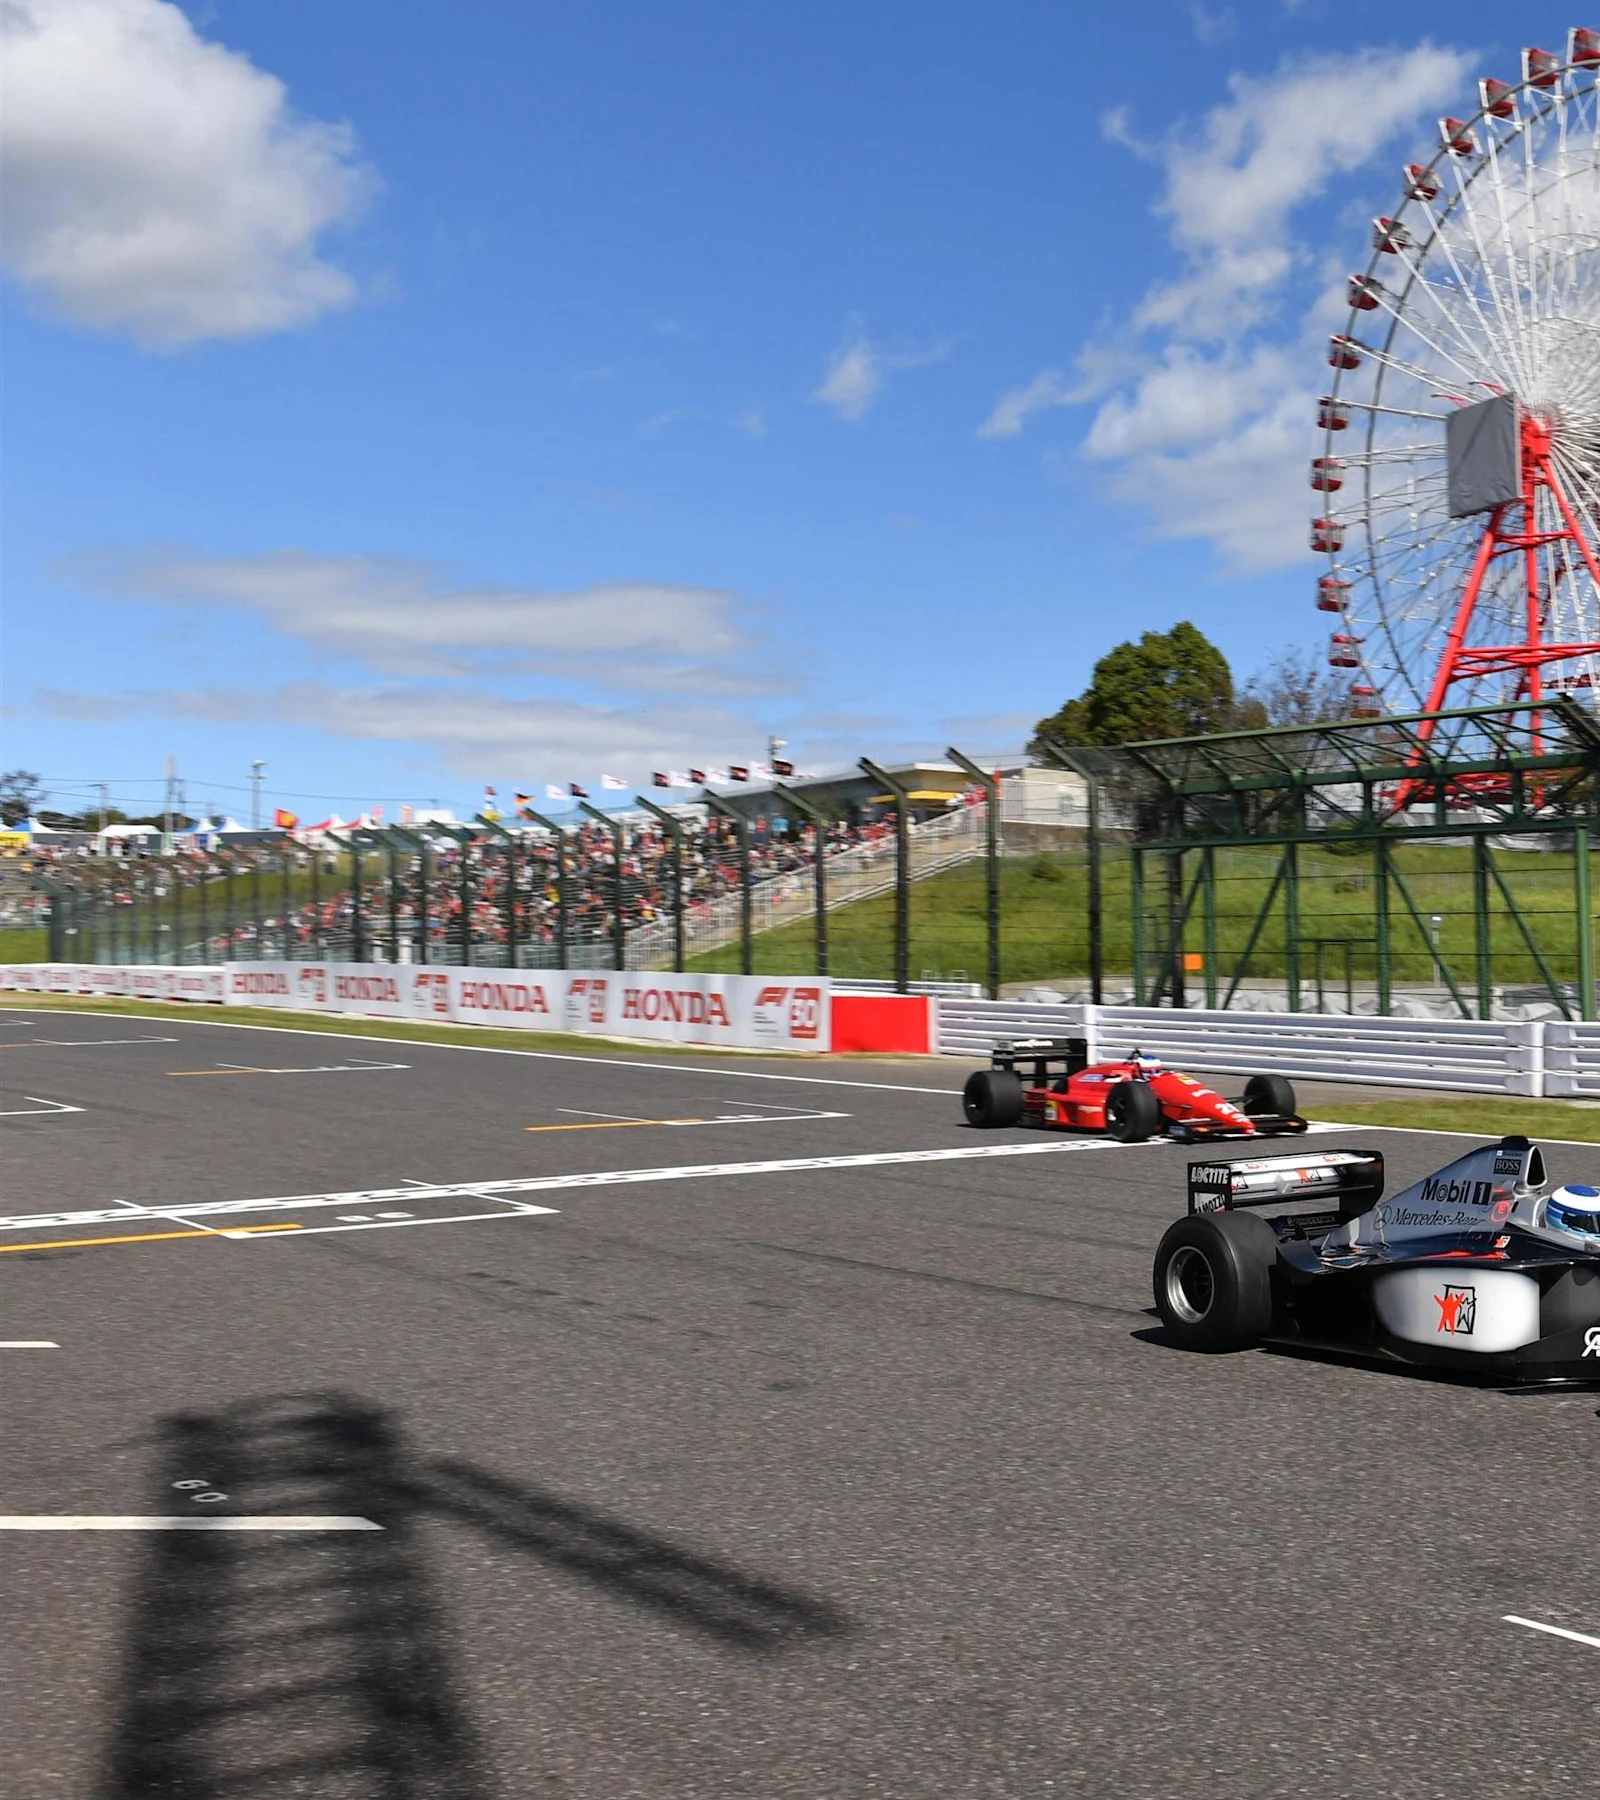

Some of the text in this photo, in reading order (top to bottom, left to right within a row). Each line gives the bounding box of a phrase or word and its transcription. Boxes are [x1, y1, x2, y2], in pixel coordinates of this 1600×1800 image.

[335, 975, 400, 1002] HONDA
[460, 982, 550, 1013] HONDA
[621, 988, 732, 1026] HONDA
[1191, 1166, 1229, 1184] LOCTITE
[1495, 1159, 1520, 1171] BOSS
[1421, 1179, 1471, 1203] Mobil
[1391, 1207, 1486, 1226] Mercedes-Benz
